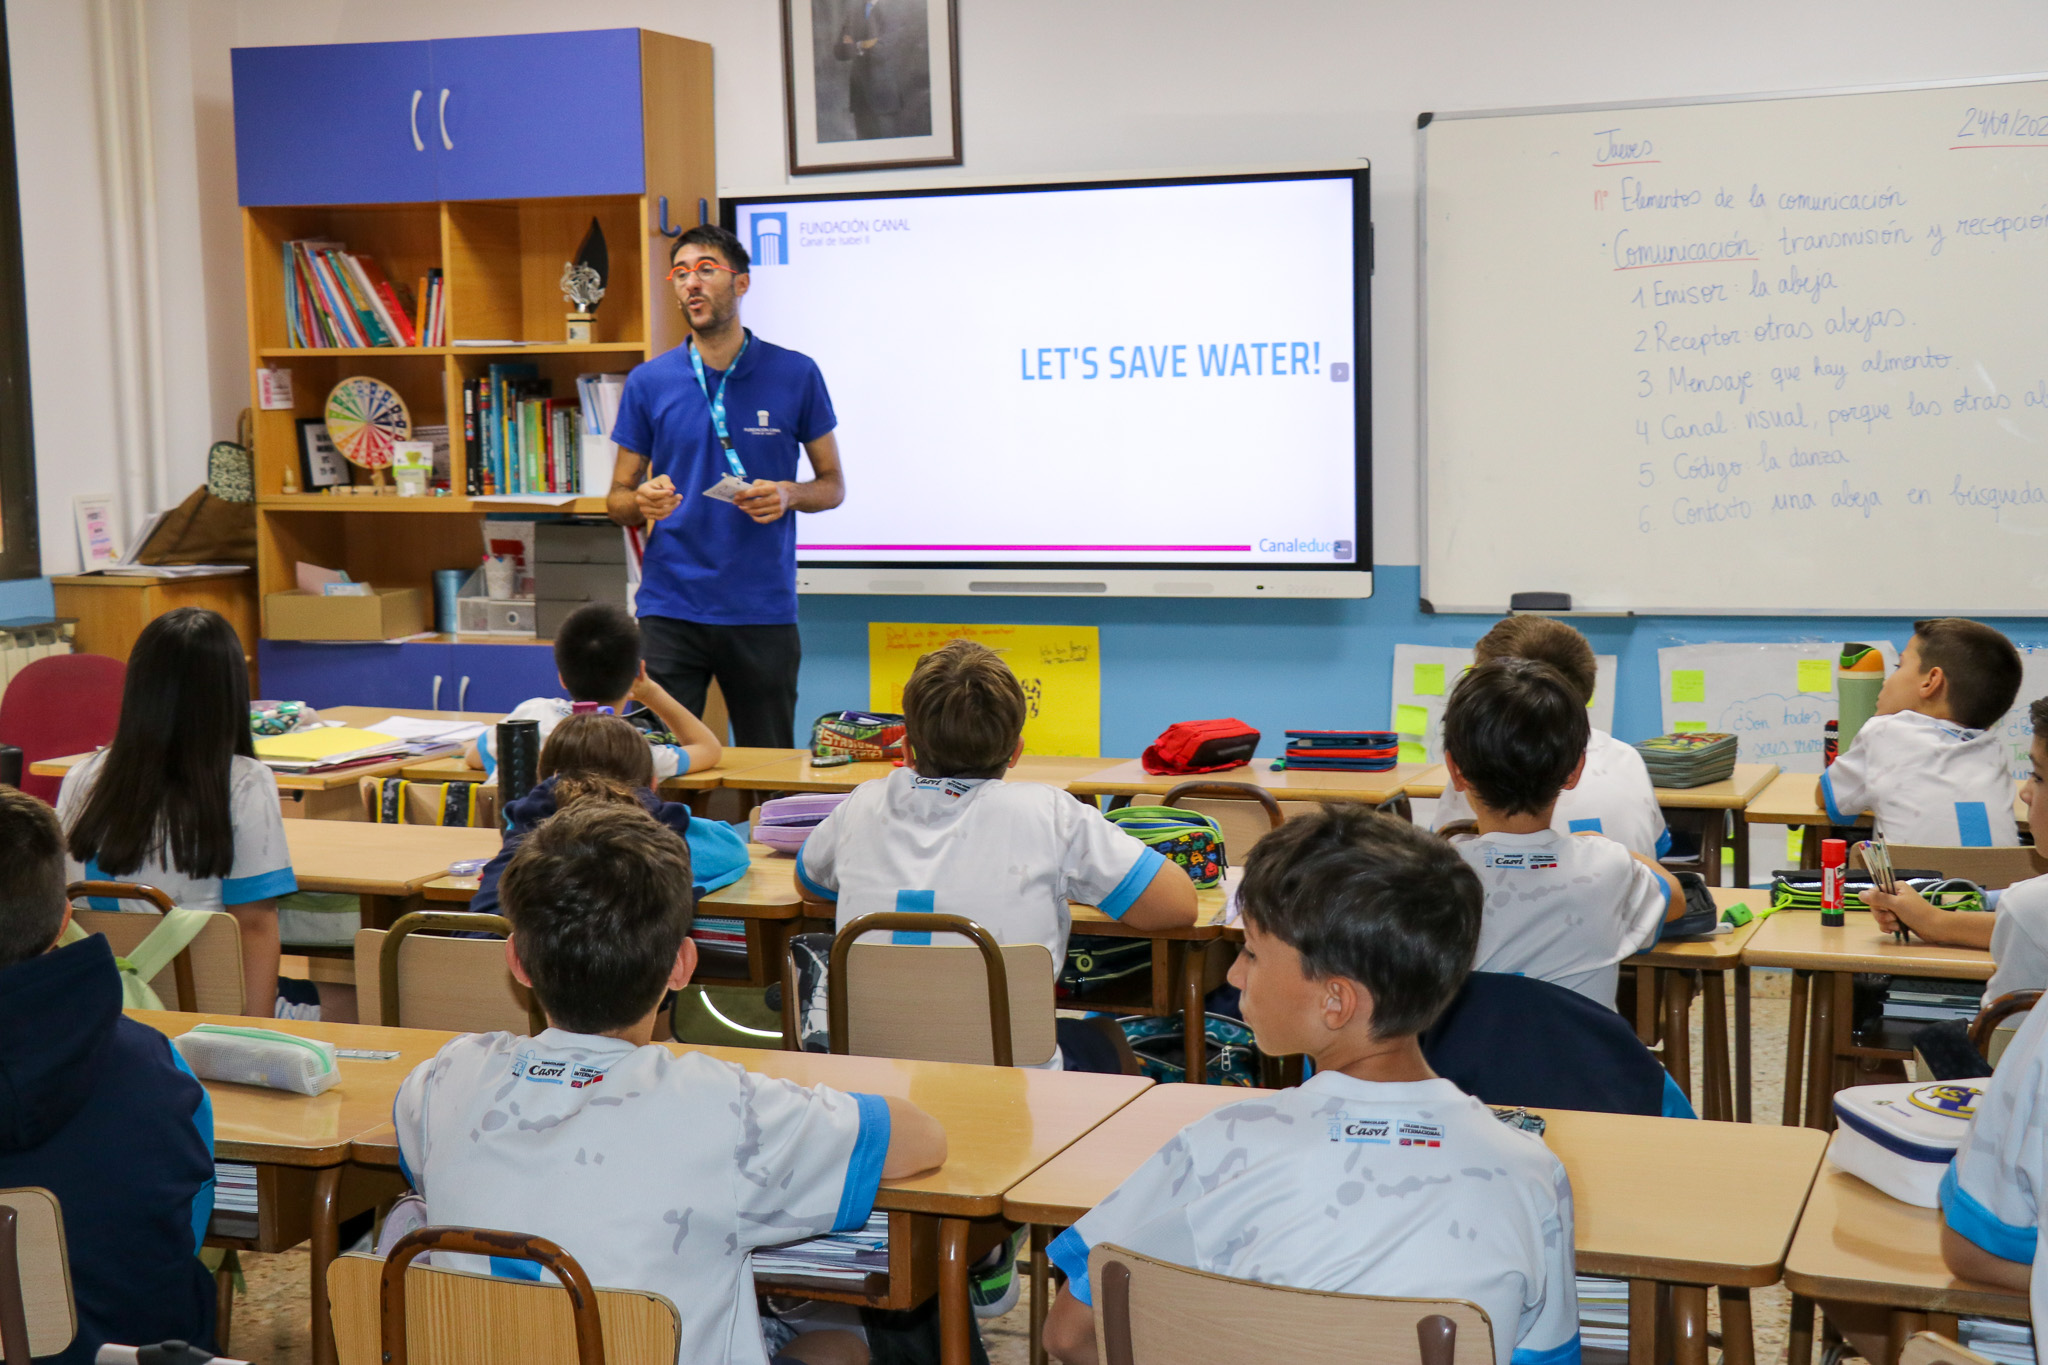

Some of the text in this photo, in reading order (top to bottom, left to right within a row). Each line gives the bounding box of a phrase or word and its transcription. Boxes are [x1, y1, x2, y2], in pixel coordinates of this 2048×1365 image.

[1594, 128, 1653, 163] Jueves
[1621, 176, 1702, 212] Elementos
[1715, 186, 1735, 208] de
[1749, 183, 1767, 208] la
[1778, 186, 1907, 211] comunicación
[800, 218, 911, 235] FUNDACIÓN CANAL
[800, 237, 824, 247] Canal
[826, 238, 837, 246] de
[839, 236, 862, 245] Isabel
[1778, 220, 1913, 255] transmisión
[1927, 223, 1947, 257] y
[1956, 204, 2048, 242] recepció
[1749, 269, 1771, 298] la
[1778, 265, 1839, 304] abeja
[1754, 314, 1813, 342] otras
[1021, 341, 1320, 380] LET'S SAVE WATER!
[1637, 370, 1653, 398] 3
[1771, 366, 1800, 392] que
[1814, 356, 1848, 390] hay
[1828, 403, 1893, 437] porque
[1907, 391, 1942, 417] las
[1953, 386, 2011, 414] otras
[1758, 440, 1781, 472] la
[1789, 447, 1850, 468] danza
[1771, 492, 1816, 510] una
[1831, 479, 1883, 519] abeja
[1907, 487, 1932, 505] en
[1950, 474, 2048, 523] búsqueda
[1784, 706, 1821, 726] todos
[528, 1065, 565, 1077] Casvi
[1345, 1124, 1389, 1136] Casvi
